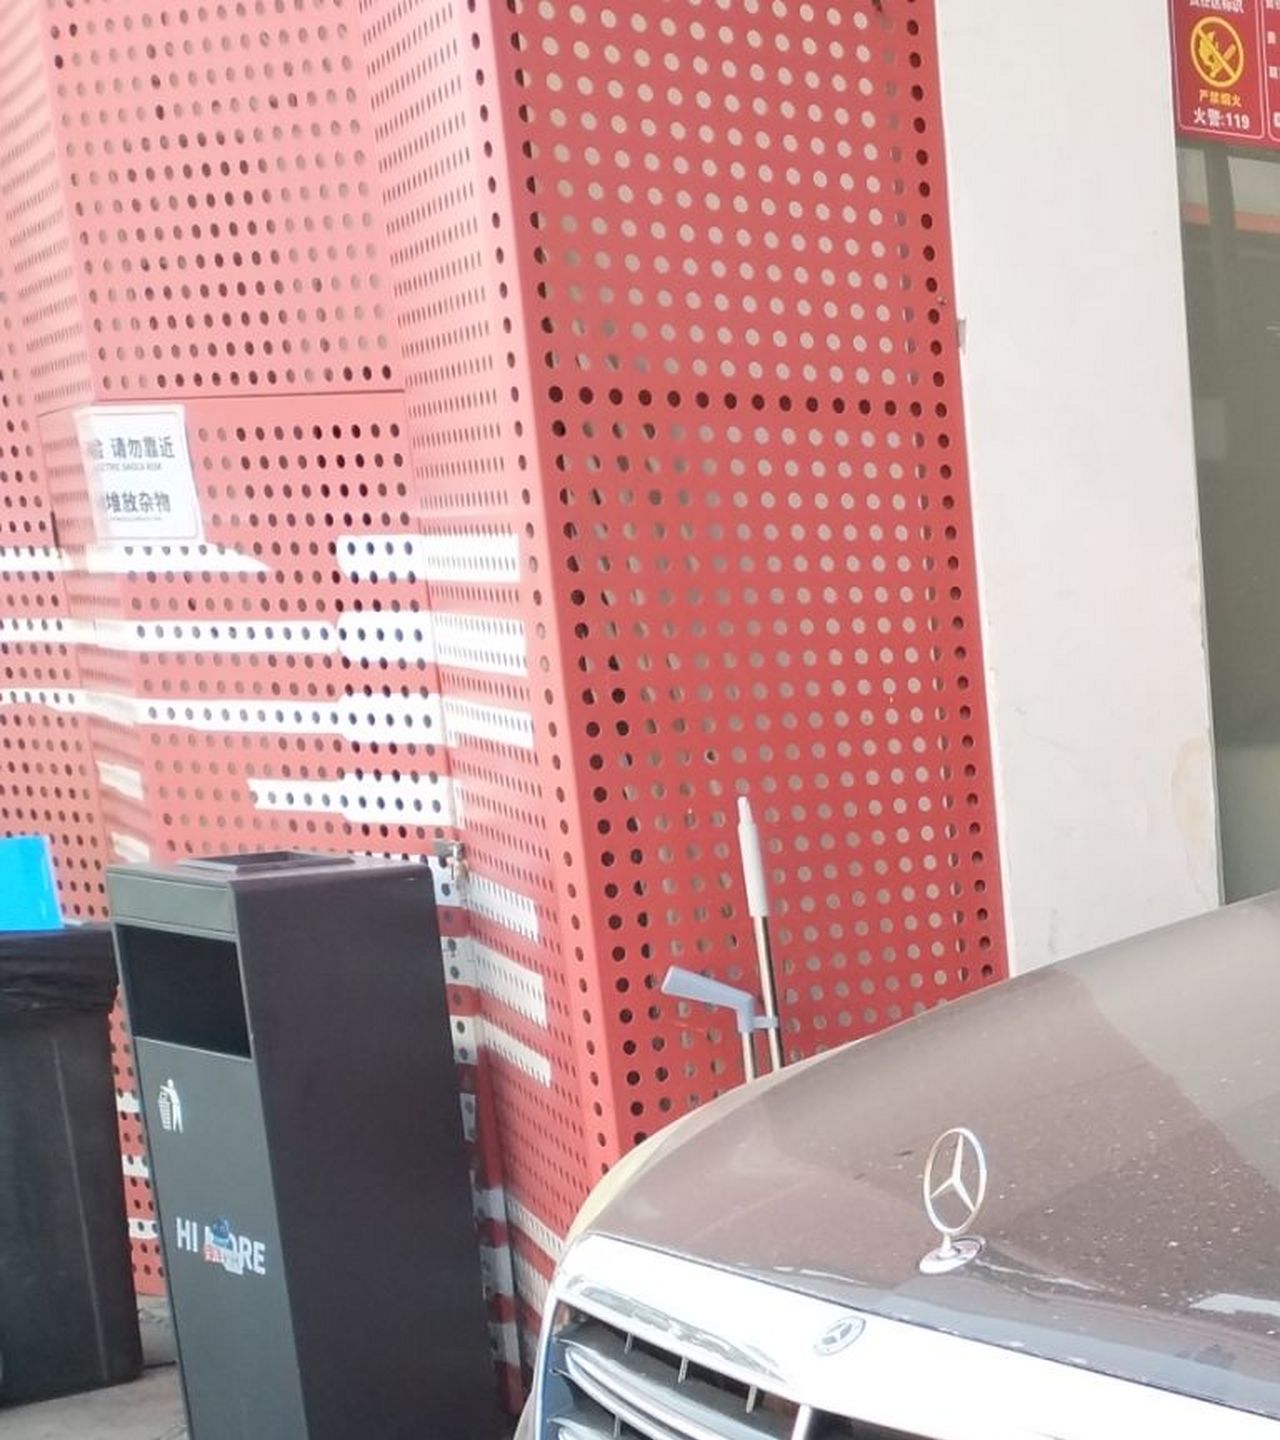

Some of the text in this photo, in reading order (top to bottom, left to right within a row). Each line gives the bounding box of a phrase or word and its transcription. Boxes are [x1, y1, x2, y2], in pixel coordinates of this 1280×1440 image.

[1199, 89, 1242, 108] 严禁烟火
[110, 435, 175, 460] 请勿靠近
[98, 490, 171, 514] 堆放杂物
[176, 1216, 198, 1253] HI
